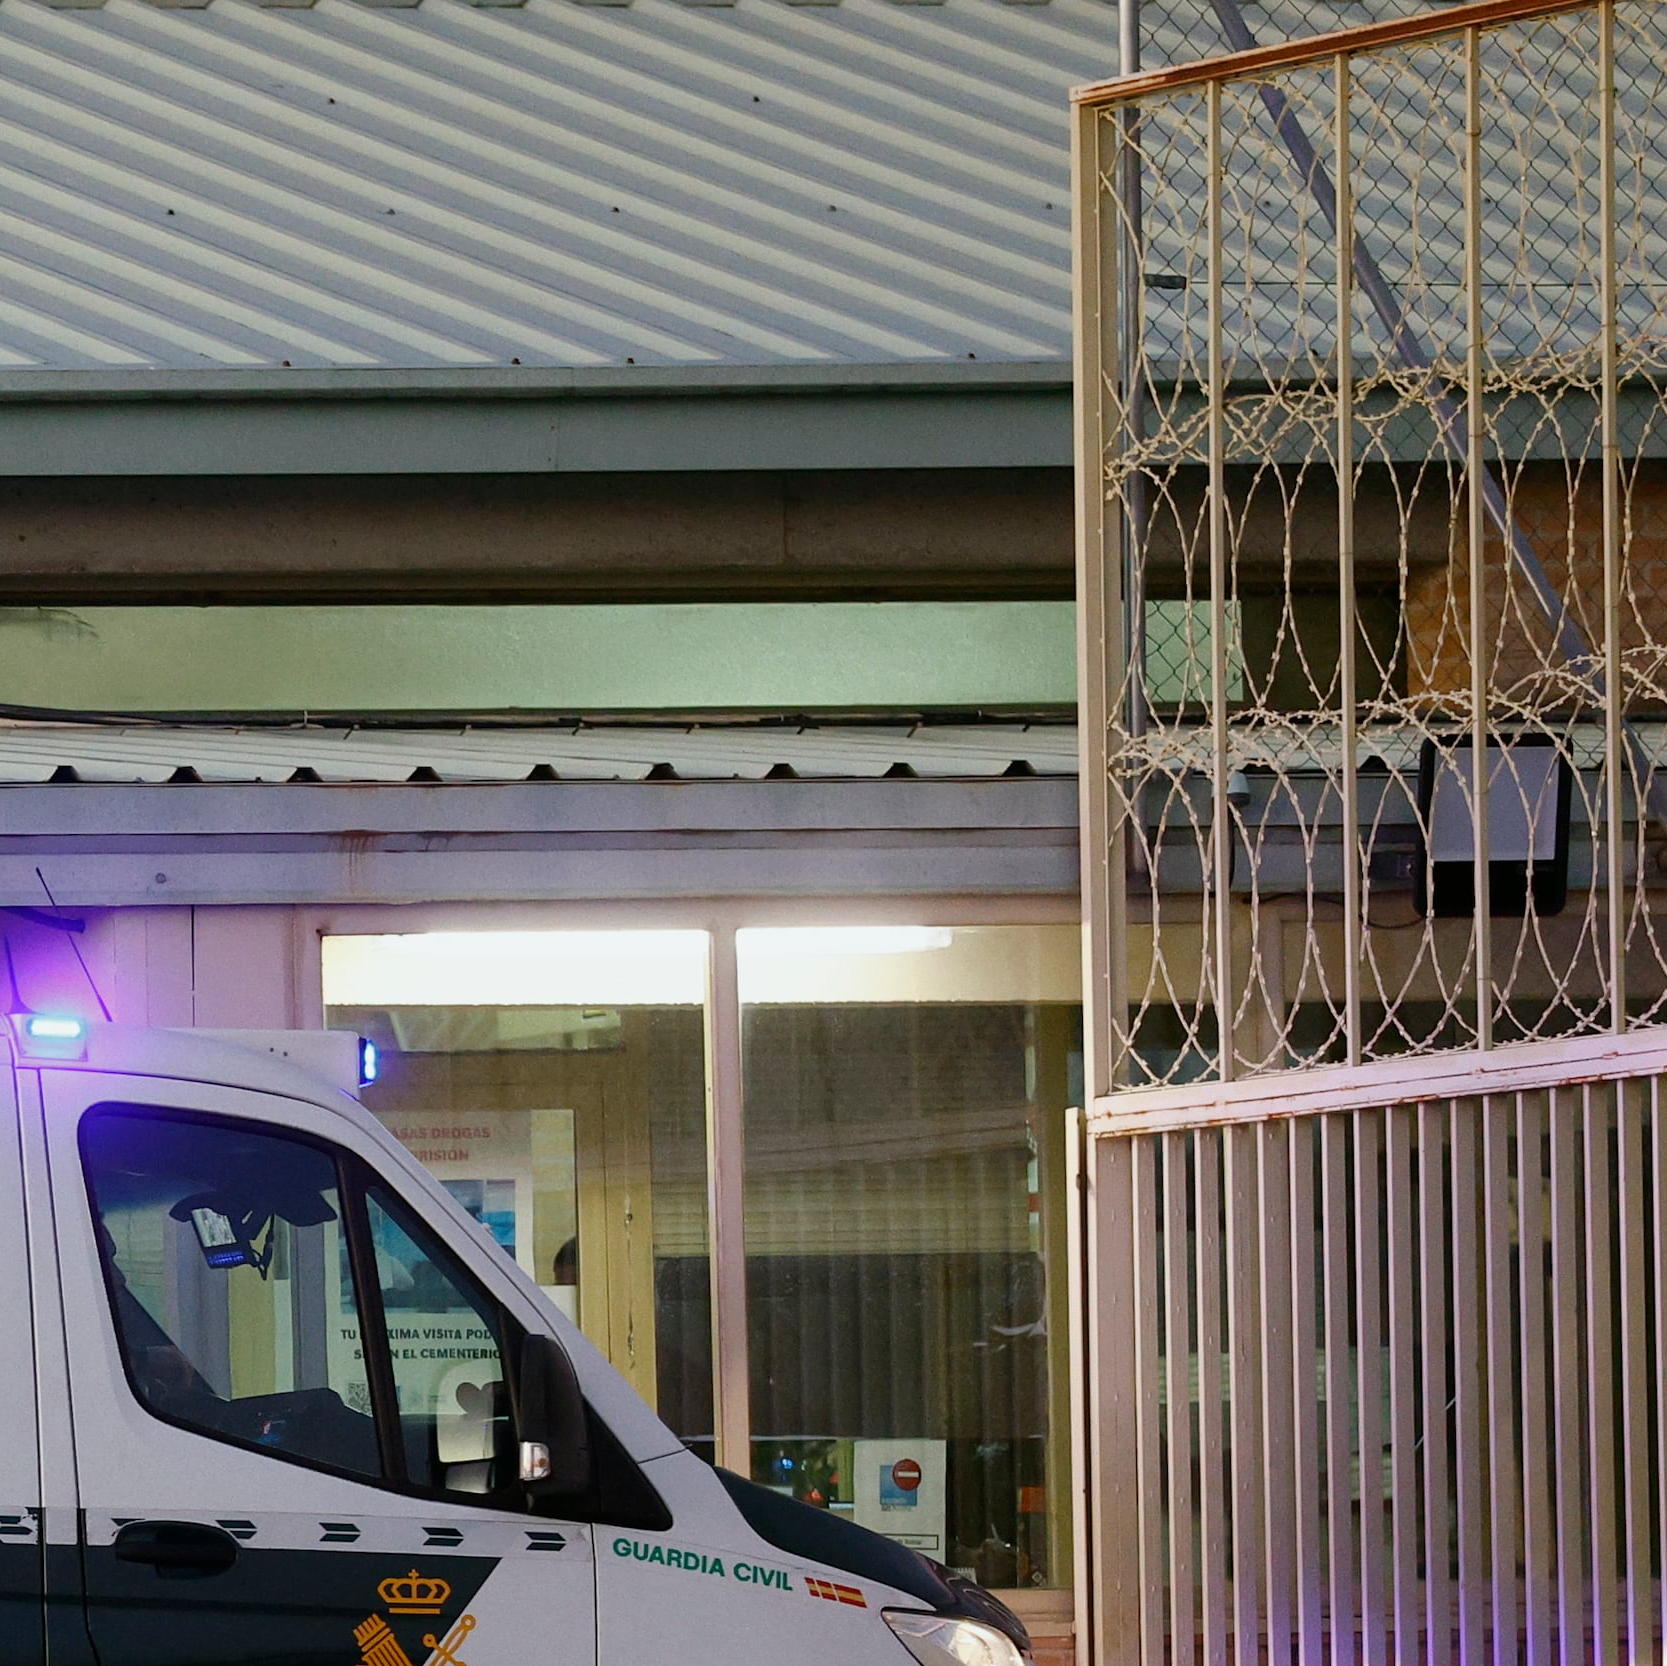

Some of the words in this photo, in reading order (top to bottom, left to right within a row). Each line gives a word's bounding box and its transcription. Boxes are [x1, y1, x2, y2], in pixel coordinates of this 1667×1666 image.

[431, 1127, 491, 1139] DROGAS
[341, 1329, 356, 1340] TU
[423, 1328, 462, 1340] VISITA
[403, 1349, 417, 1359] EL
[612, 1538, 725, 1577] GUARDIA
[733, 1562, 793, 1591] CIVIL
